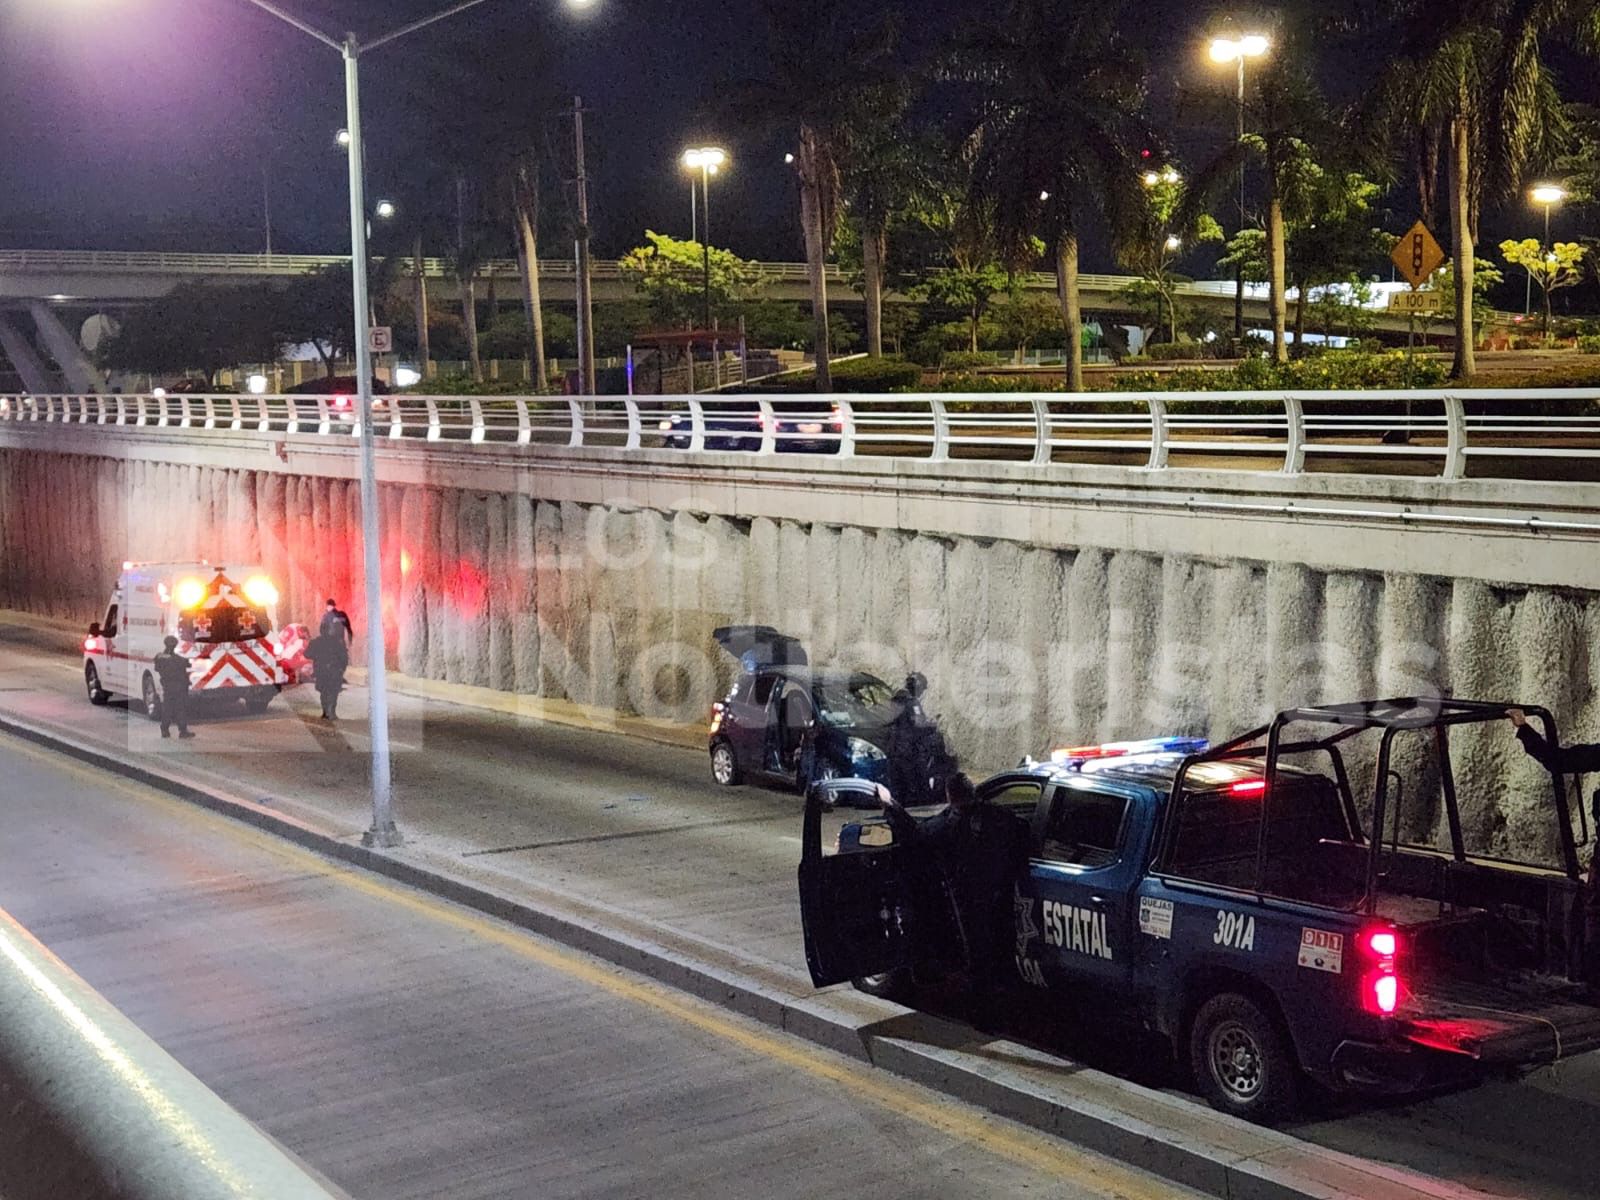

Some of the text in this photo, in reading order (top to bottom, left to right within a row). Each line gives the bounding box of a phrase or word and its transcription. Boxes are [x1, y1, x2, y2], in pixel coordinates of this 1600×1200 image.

[1392, 294, 1439, 308] A 100 m
[1141, 898, 1172, 911] QUEJAS
[1042, 899, 1113, 960] ESTATAL
[1213, 910, 1255, 951] 301A
[1303, 930, 1340, 950] 911
